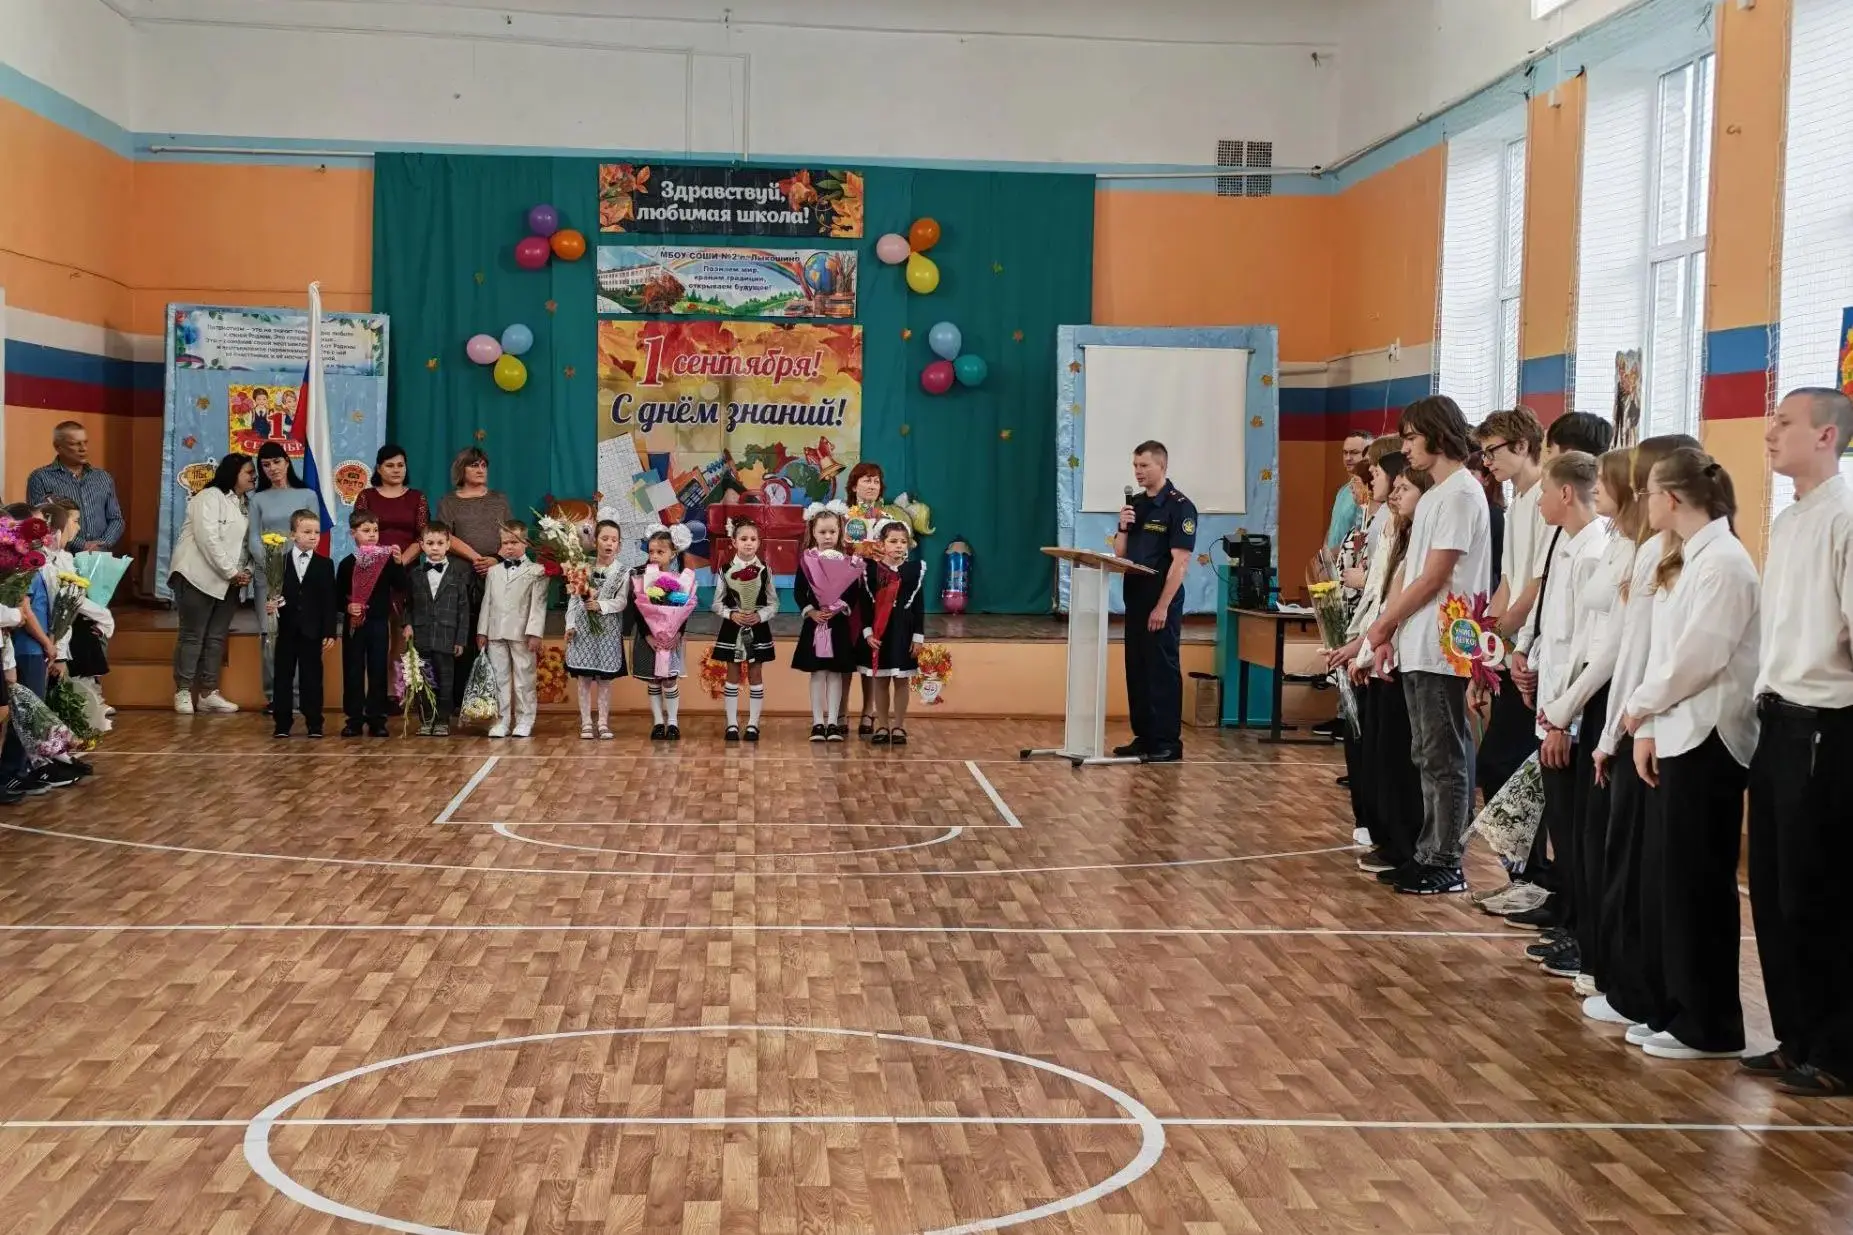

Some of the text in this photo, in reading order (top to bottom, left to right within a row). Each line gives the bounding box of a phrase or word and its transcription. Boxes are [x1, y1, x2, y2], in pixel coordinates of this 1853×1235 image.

[661, 180, 786, 204] Здравствуй,
[637, 203, 810, 224] любимая школа!
[660, 251, 687, 259] МБОУ
[689, 252, 720, 260] СОШИ
[750, 253, 801, 262] Лыкошино
[637, 335, 825, 387] 1 сентября!
[267, 411, 287, 439] 1
[611, 392, 847, 433] С днём знаний!
[1478, 631, 1505, 667] 9
